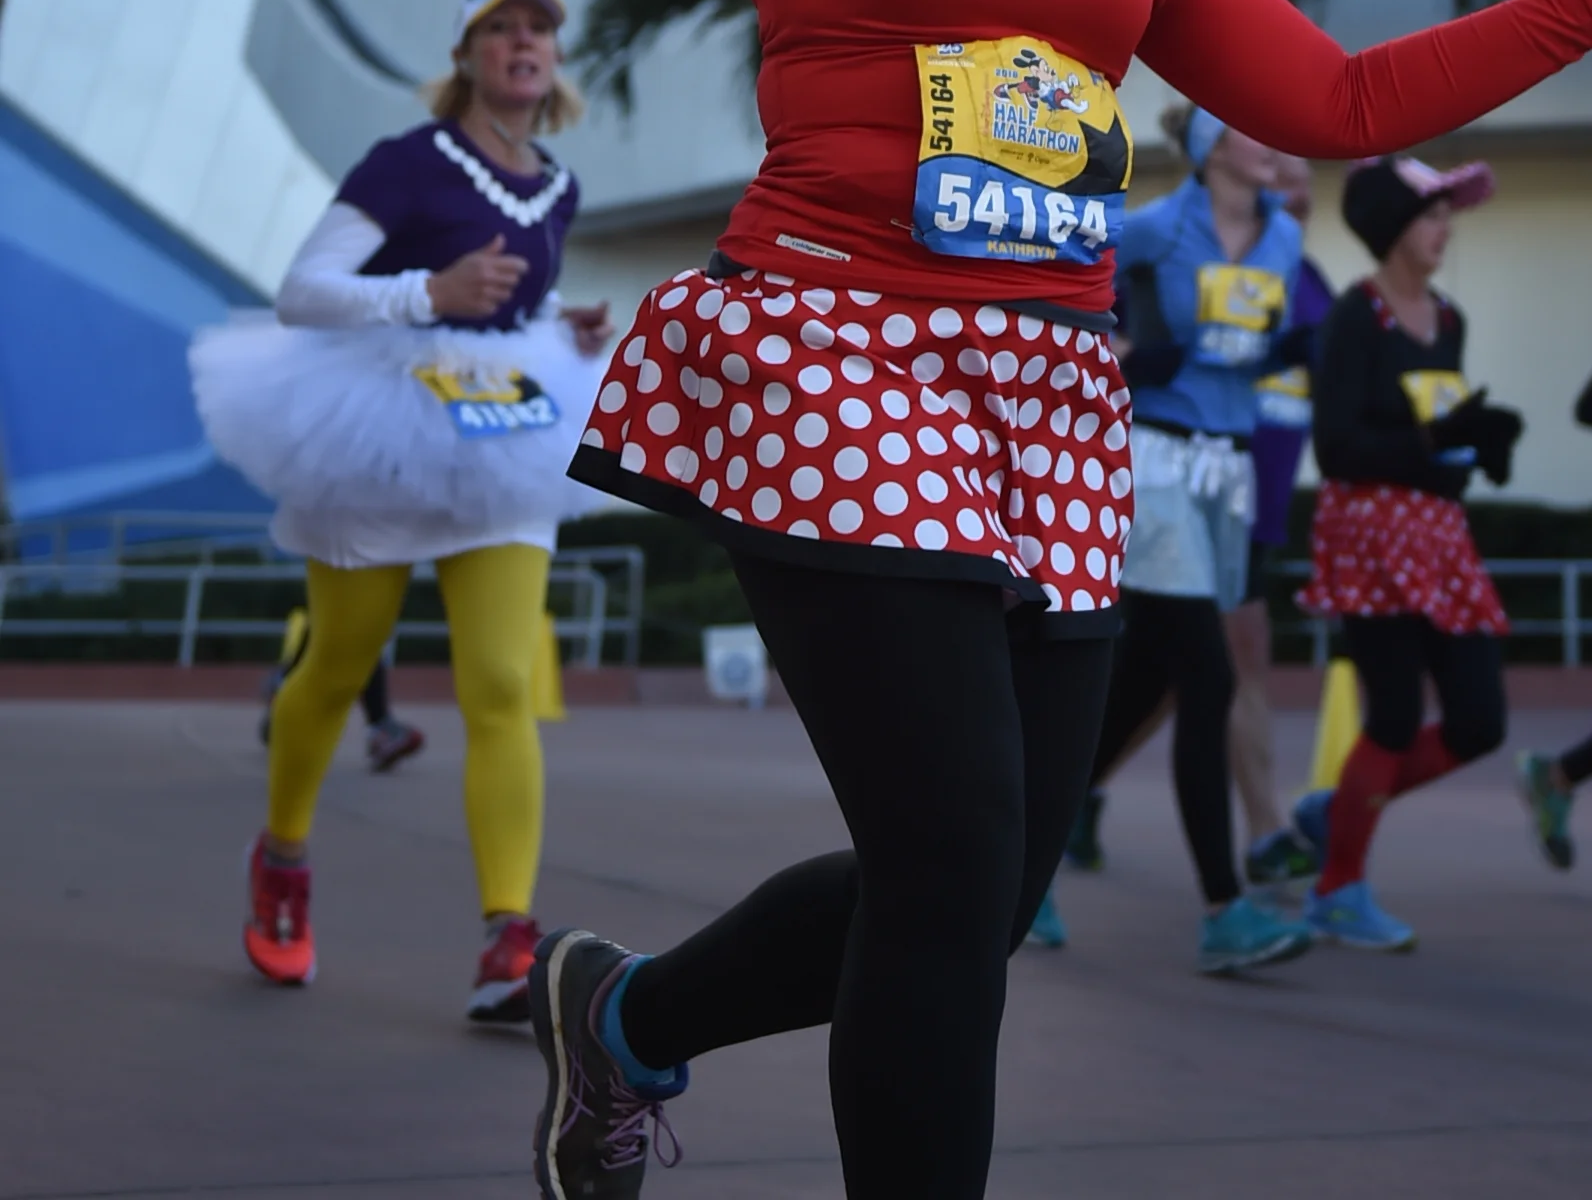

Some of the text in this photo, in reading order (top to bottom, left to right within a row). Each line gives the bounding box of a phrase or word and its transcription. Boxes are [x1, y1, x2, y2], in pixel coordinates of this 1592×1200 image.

[930, 73, 954, 151] 54164
[994, 103, 1037, 125] HALF
[992, 122, 1080, 154] MARATHON
[934, 173, 1108, 249] 54164
[986, 240, 1056, 260] KATHRYN
